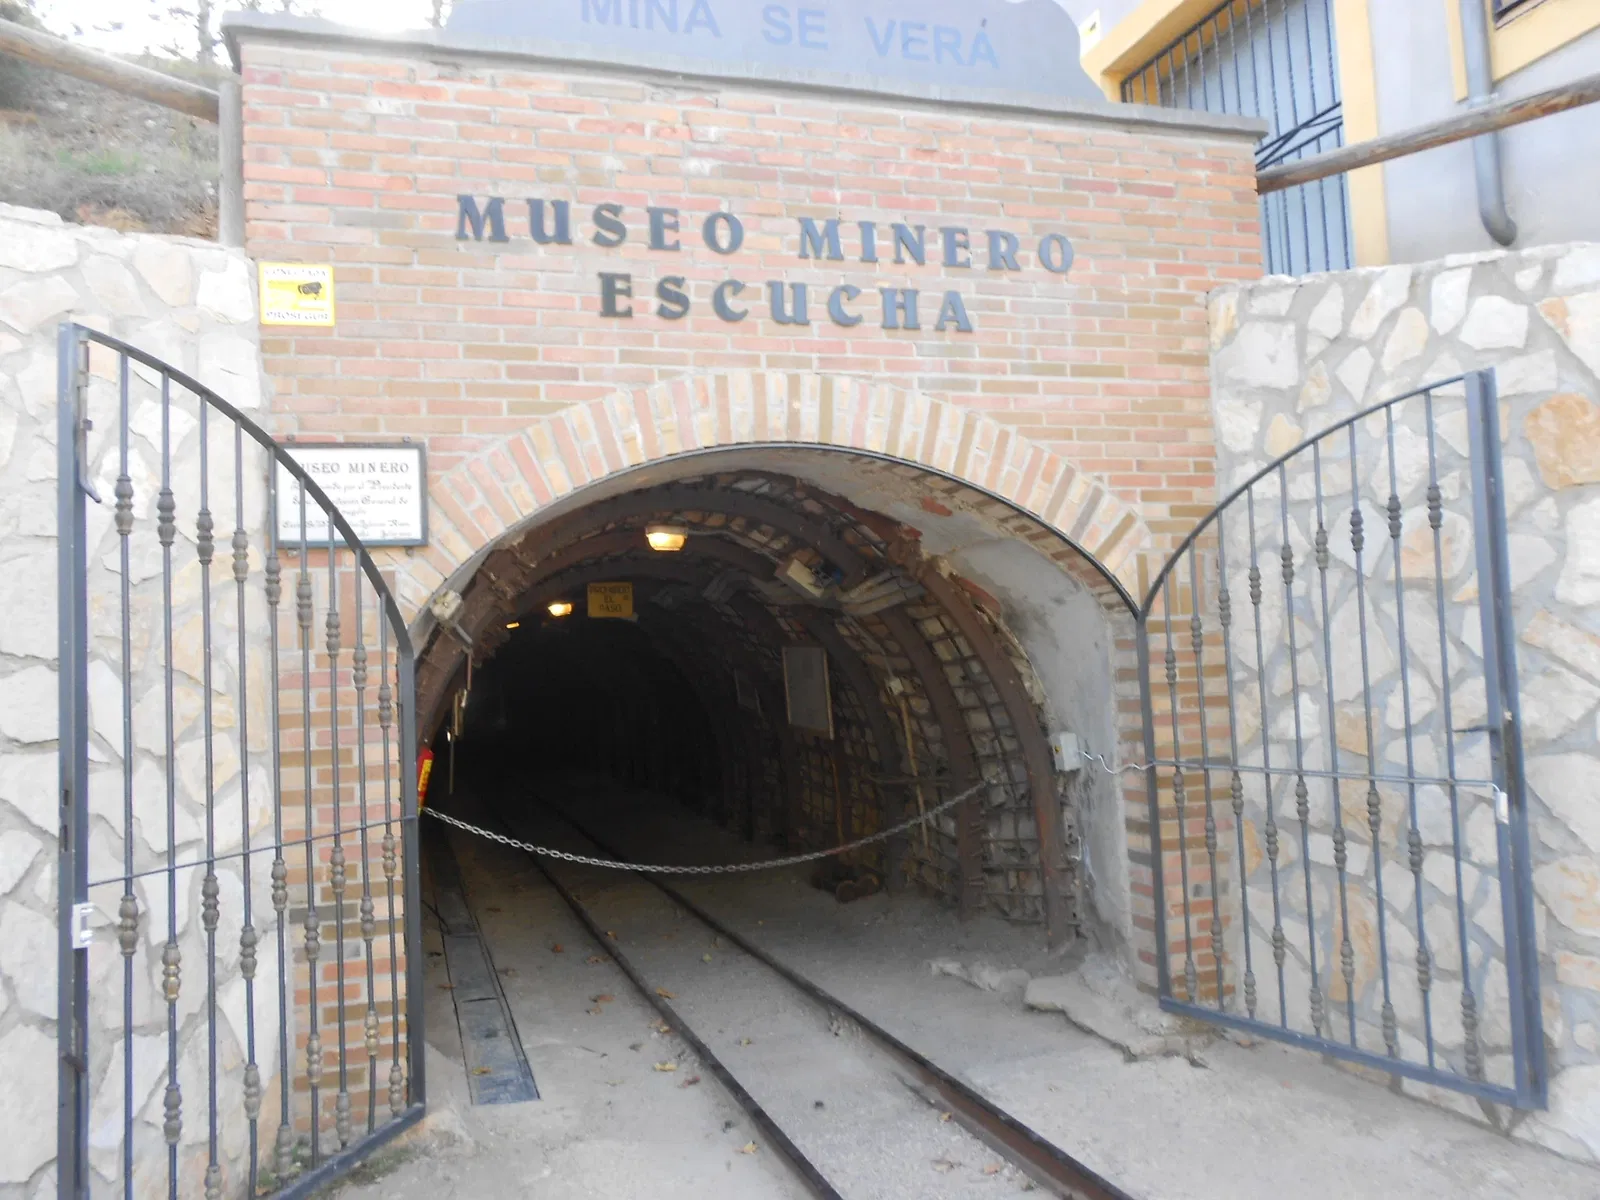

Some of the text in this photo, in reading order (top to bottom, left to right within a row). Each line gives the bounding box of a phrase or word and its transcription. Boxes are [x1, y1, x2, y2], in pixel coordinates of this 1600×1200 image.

[580, 0, 1001, 70] MINA SE VERÁ
[455, 194, 1074, 273] MUSEO MINERO
[598, 271, 973, 333] ESCUCHA
[300, 461, 409, 474] USEO MINERO
[599, 603, 622, 613] PASO
